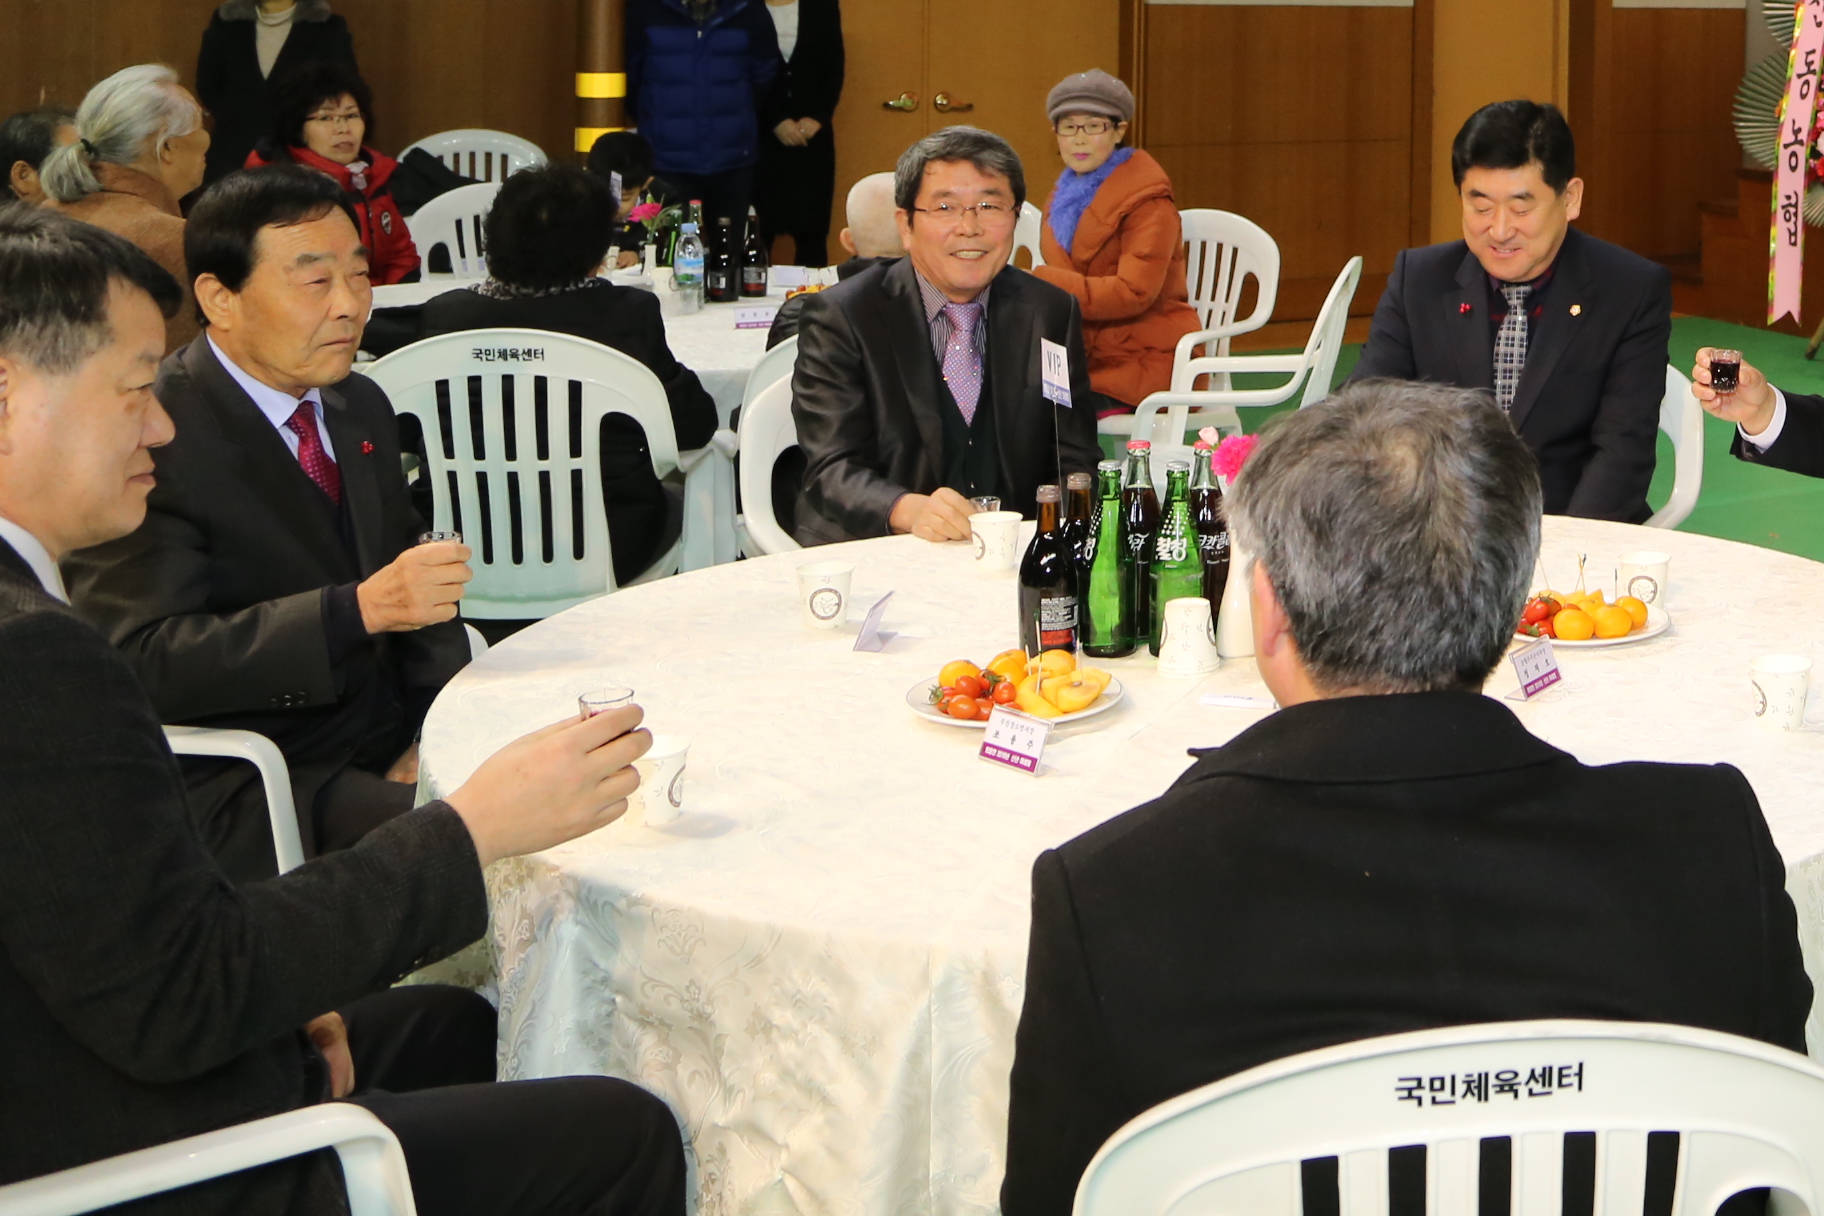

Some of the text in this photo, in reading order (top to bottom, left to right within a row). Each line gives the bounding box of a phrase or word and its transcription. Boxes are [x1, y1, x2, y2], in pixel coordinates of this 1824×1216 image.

[471, 348, 545, 362] 국민체육센터
[1047, 350, 1062, 376] VIP
[1394, 1061, 1585, 1108] 국민체육센터
